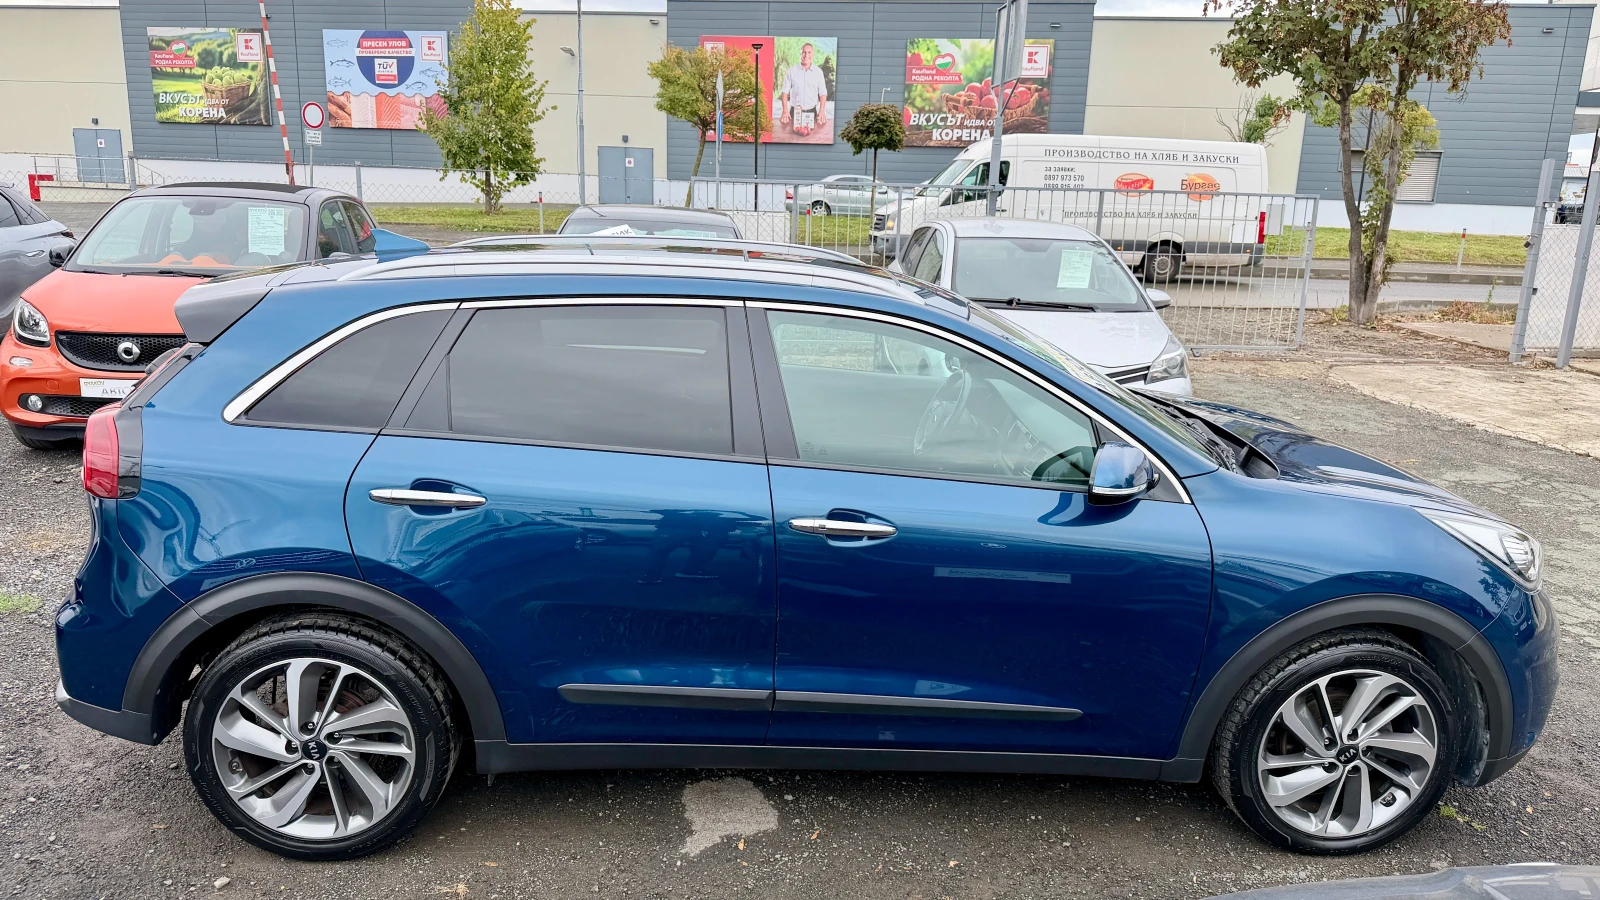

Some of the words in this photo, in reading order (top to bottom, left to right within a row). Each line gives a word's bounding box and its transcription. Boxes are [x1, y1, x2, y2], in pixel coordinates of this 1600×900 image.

[159, 93, 201, 104] ВКУСЪТ
[179, 107, 226, 118] КОРЕНА
[910, 113, 966, 126] ВКУСЪТ
[932, 128, 991, 141] КОРЕНА
[1044, 149, 1130, 159] ПРОИЗВОДСТВО
[1193, 155, 1239, 163] ЗАКУСКИ
[308, 741, 320, 760] KIA
[1339, 749, 1357, 762] KIA
